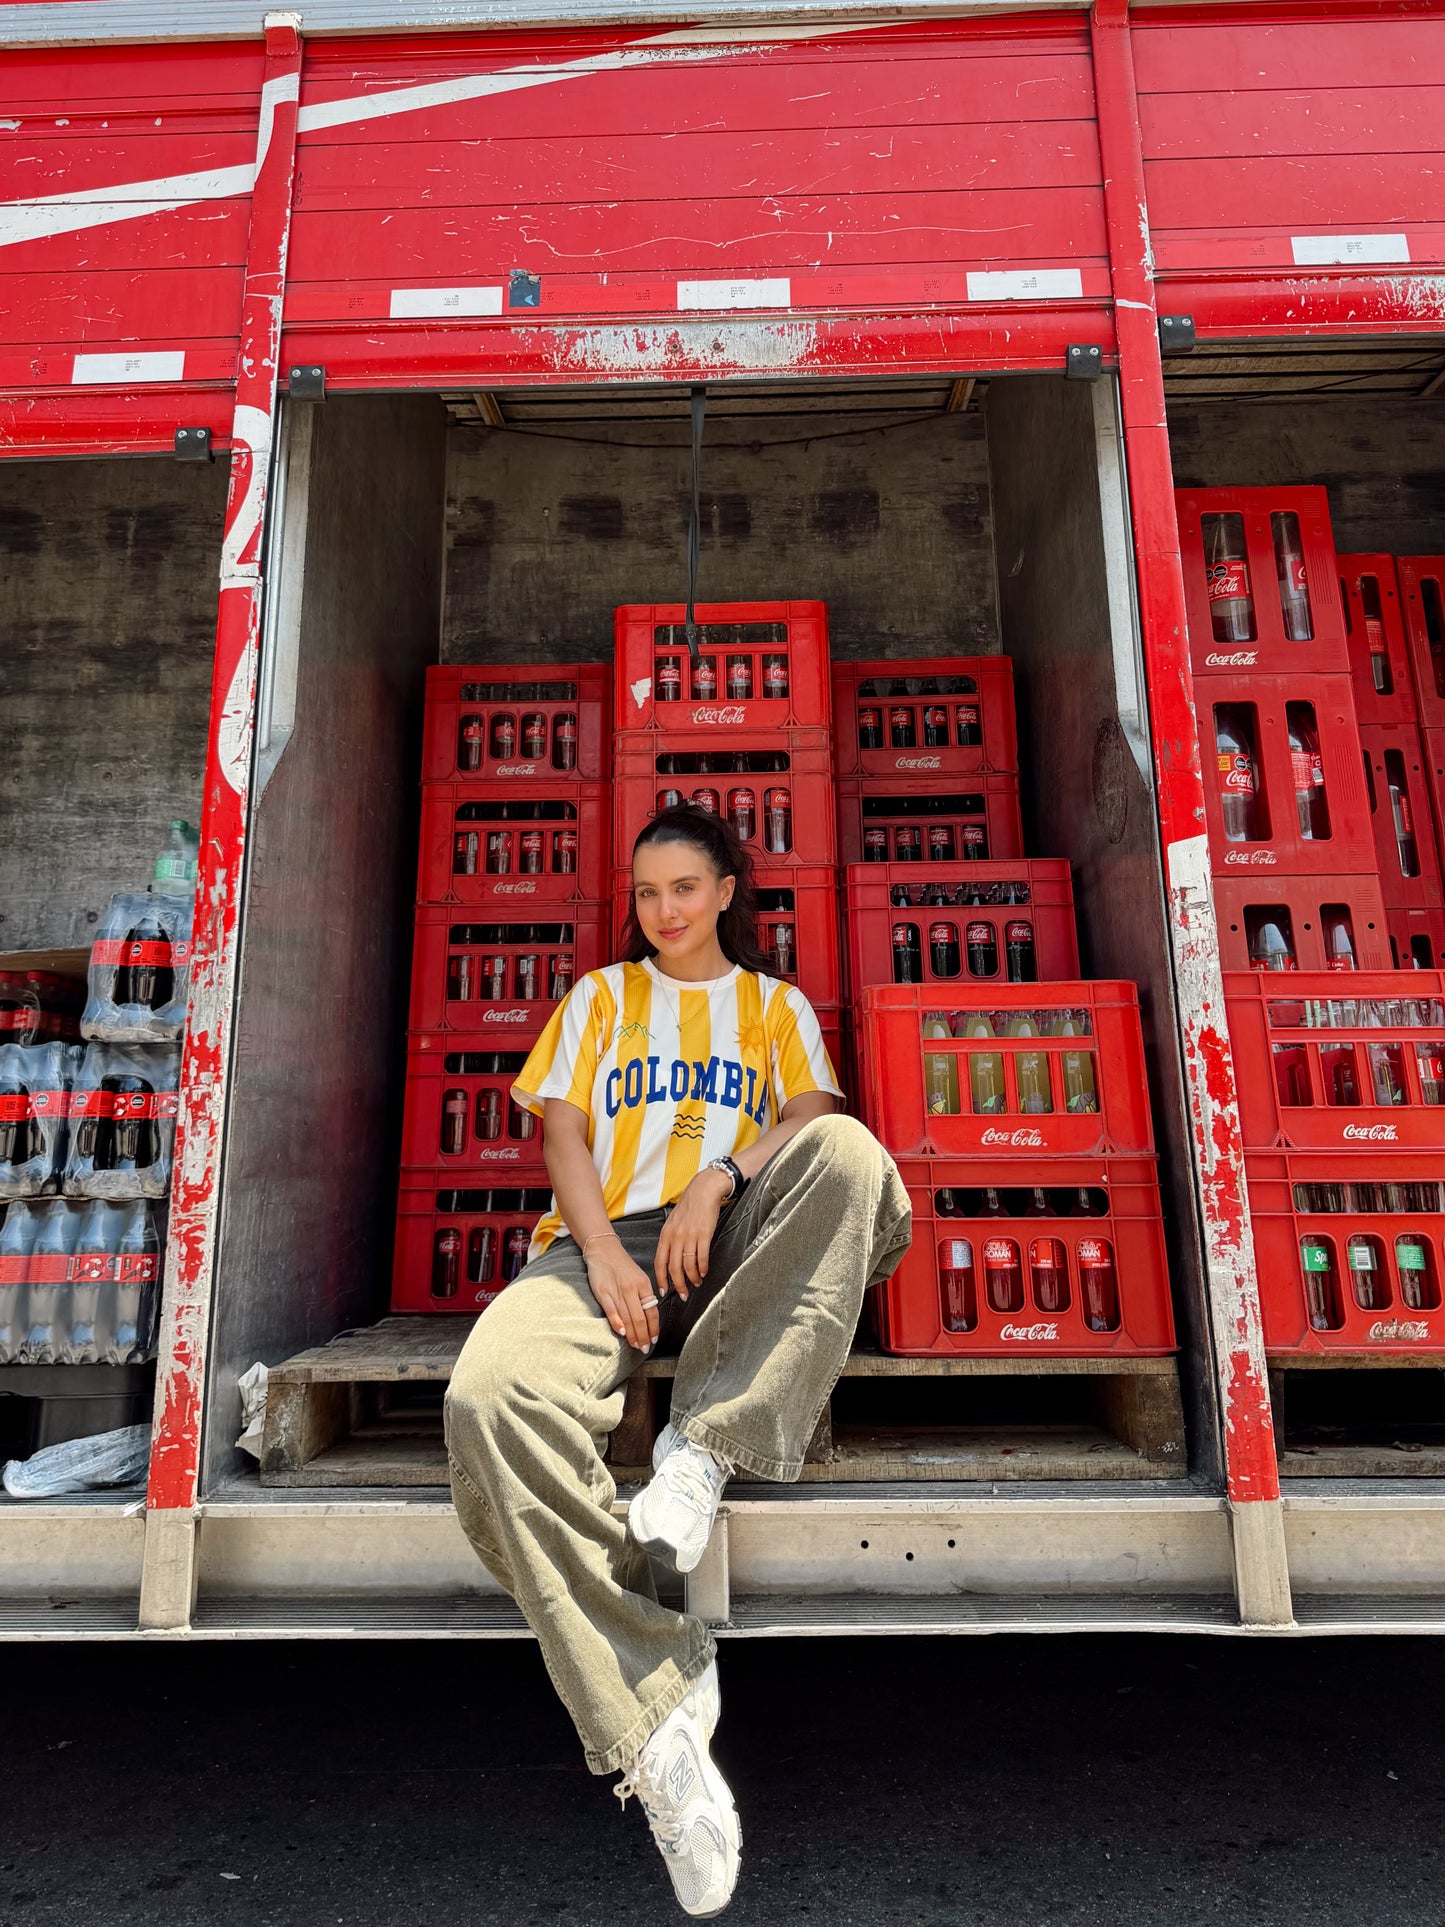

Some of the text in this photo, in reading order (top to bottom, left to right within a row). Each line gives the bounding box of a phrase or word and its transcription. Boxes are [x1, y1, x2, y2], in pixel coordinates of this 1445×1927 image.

[1208, 577, 1240, 595] a-Cola
[1205, 650, 1258, 666] Coca-Cola
[692, 705, 747, 725] Coca-Cola
[496, 764, 537, 776] Coca-Cola
[895, 755, 942, 769] Coca-Cola
[1226, 770, 1254, 787] Coca-C
[493, 880, 537, 894] Coca-Cola
[482, 1008, 531, 1023] Coca-Cola
[980, 1127, 1042, 1147] Coca-Cola
[1343, 1123, 1398, 1140] Coca-Cola
[480, 1147, 520, 1159] Coca-Cola
[475, 1289, 501, 1303] Coca-
[1000, 1322, 1058, 1341] Coca-Cola
